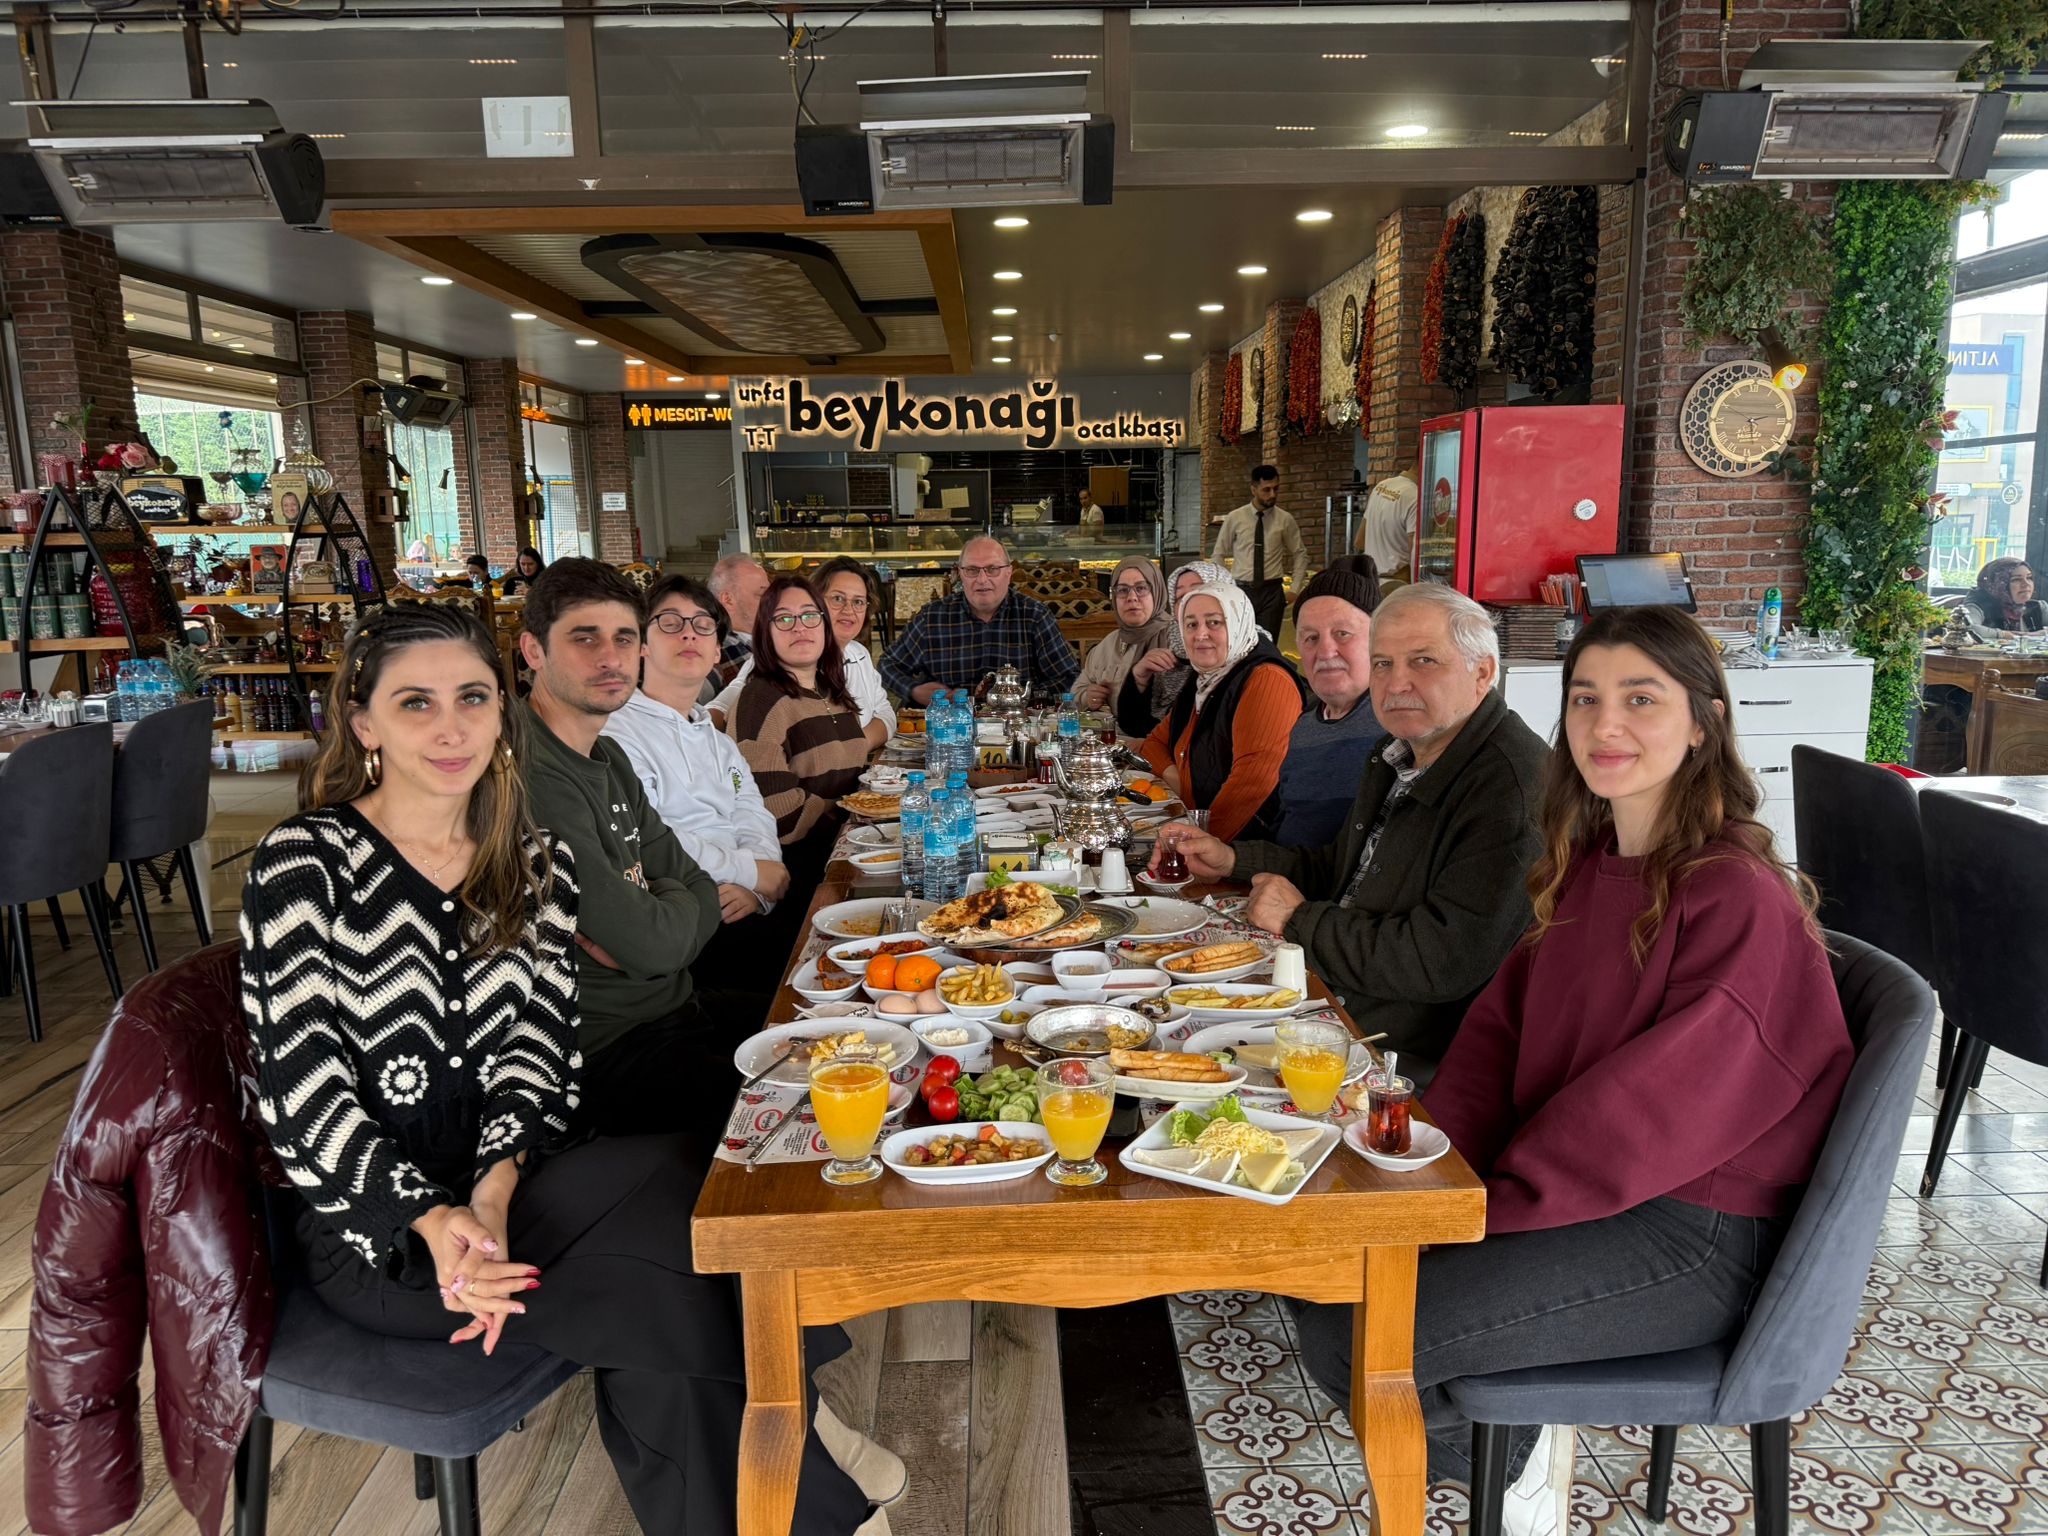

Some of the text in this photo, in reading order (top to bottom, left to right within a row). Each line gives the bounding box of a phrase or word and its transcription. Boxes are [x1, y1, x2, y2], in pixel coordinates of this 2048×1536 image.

[739, 380, 1181, 449] urfa beykonağı ocakbaşı
